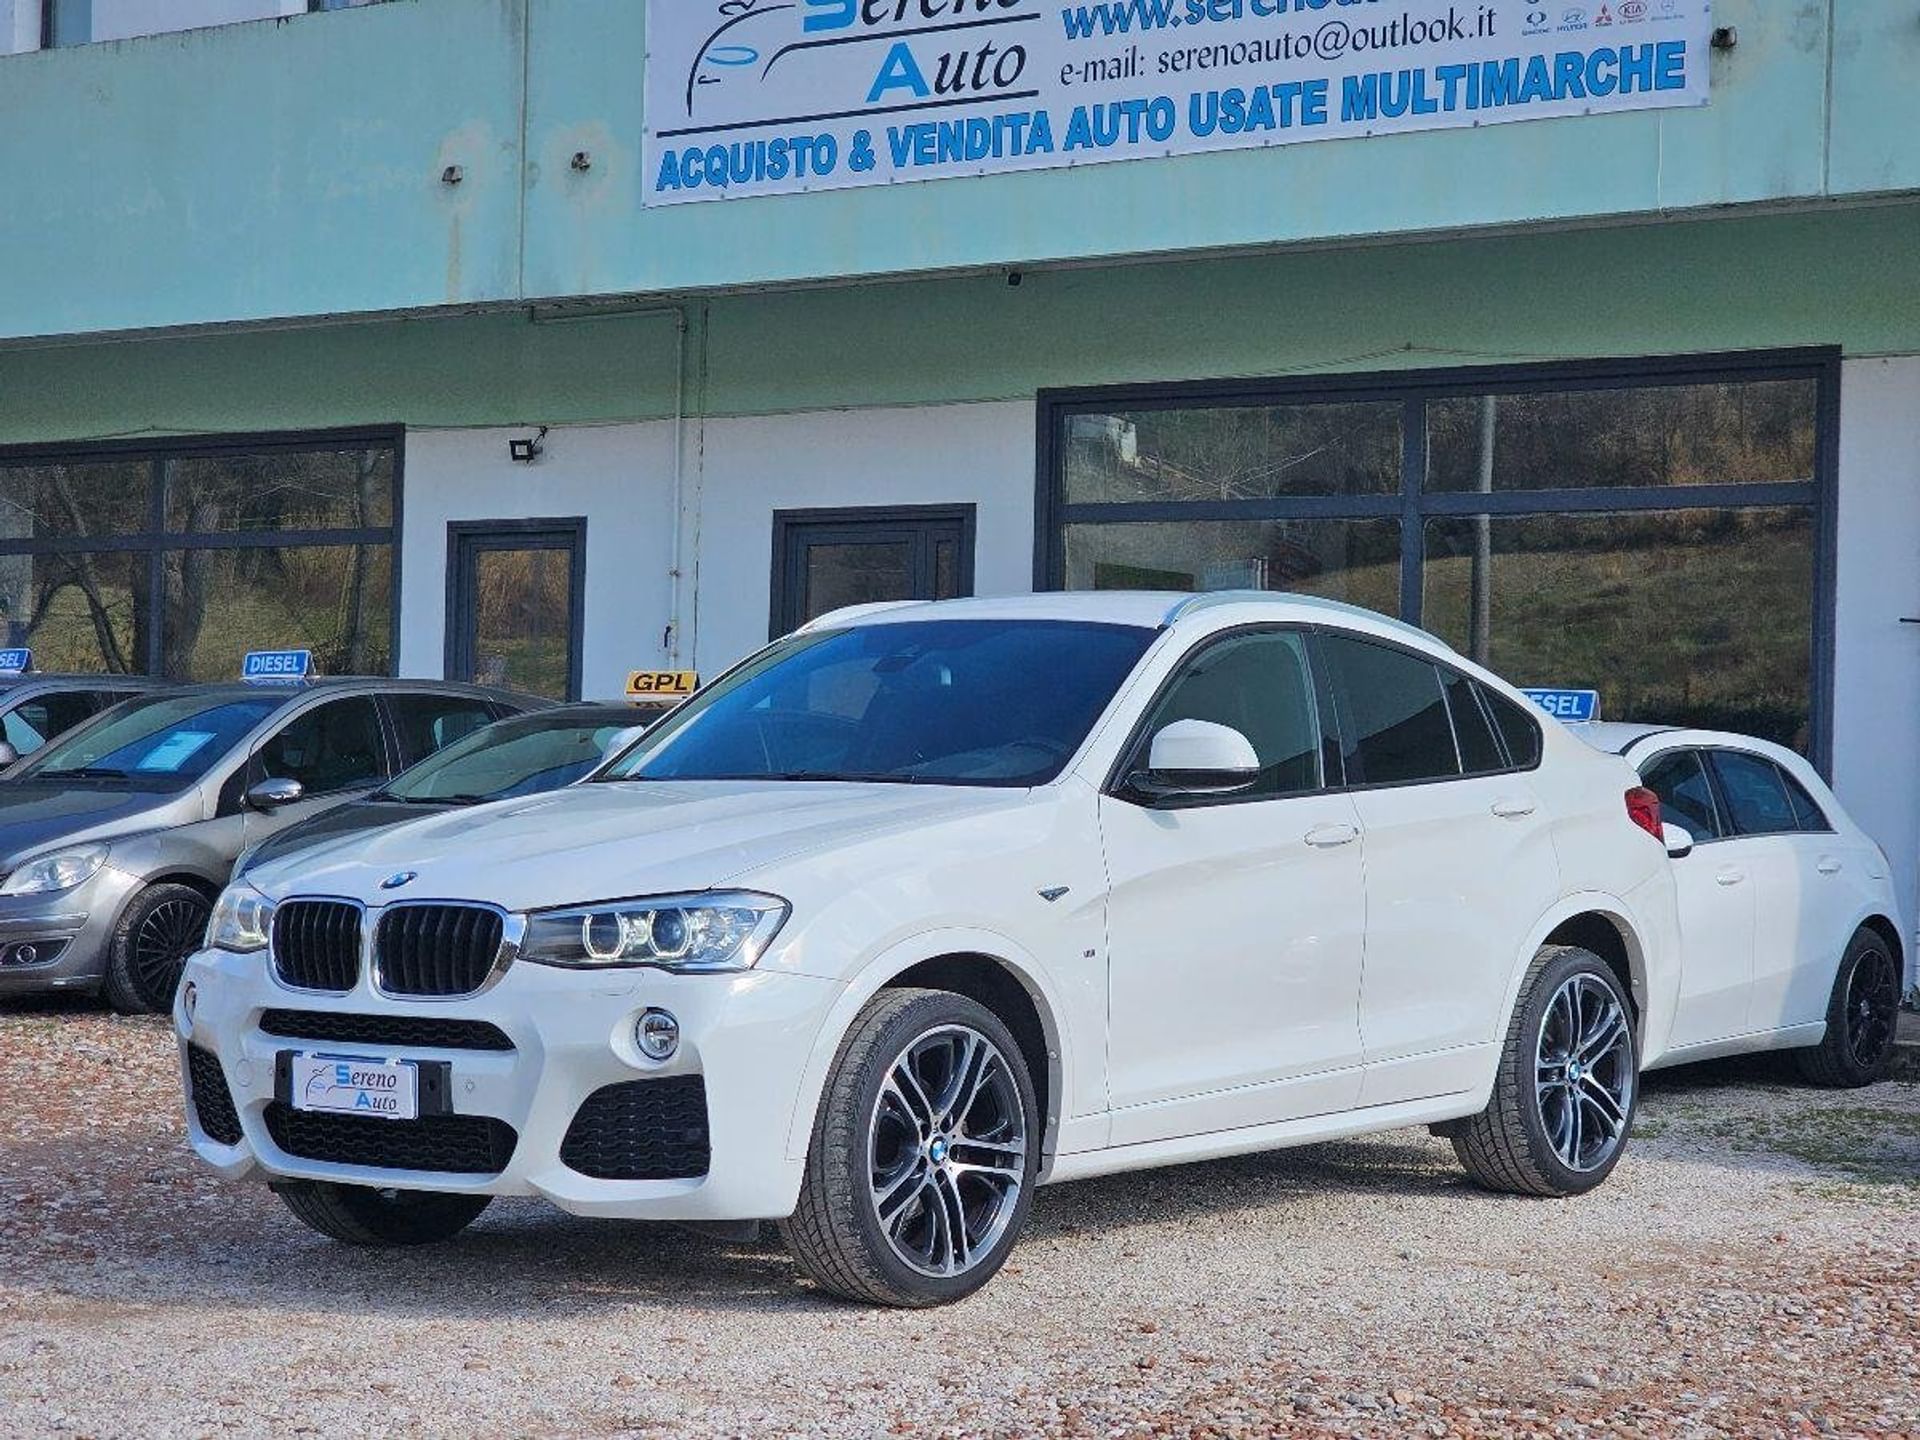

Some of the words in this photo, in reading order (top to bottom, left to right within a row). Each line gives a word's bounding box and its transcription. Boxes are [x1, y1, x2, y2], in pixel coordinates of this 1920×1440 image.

[1060, 45, 1145, 86] e-mail:
[1158, 5, 1497, 74] serenoauto@outlook.it
[865, 40, 1027, 103] Auto
[656, 133, 838, 191] ACQUISTO
[848, 129, 876, 172] &
[887, 111, 1055, 168] VENDITA
[1063, 96, 1176, 151] AUTO
[1189, 79, 1329, 137] USATE
[1341, 40, 1687, 122] MULTIMARCHE
[249, 655, 300, 673] DIESEL
[633, 673, 688, 691] GPL
[336, 1065, 397, 1089] Sereno
[355, 1091, 397, 1110] Auto
